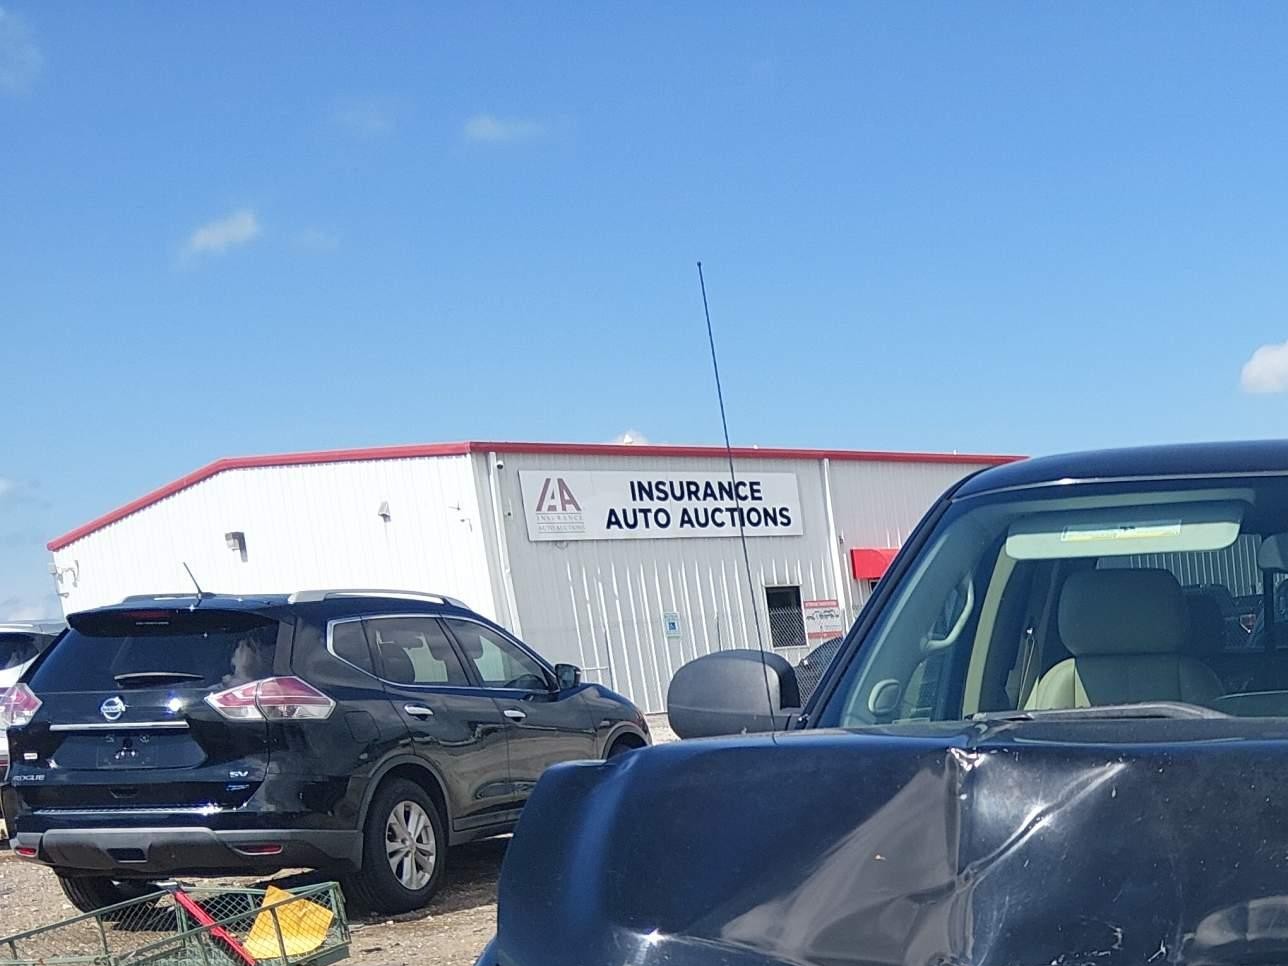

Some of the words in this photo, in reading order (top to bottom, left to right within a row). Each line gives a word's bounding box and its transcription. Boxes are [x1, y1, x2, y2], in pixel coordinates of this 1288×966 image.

[629, 480, 763, 502] INSURANCE
[605, 508, 671, 530] AUTO
[679, 507, 792, 529] AUCTIONS
